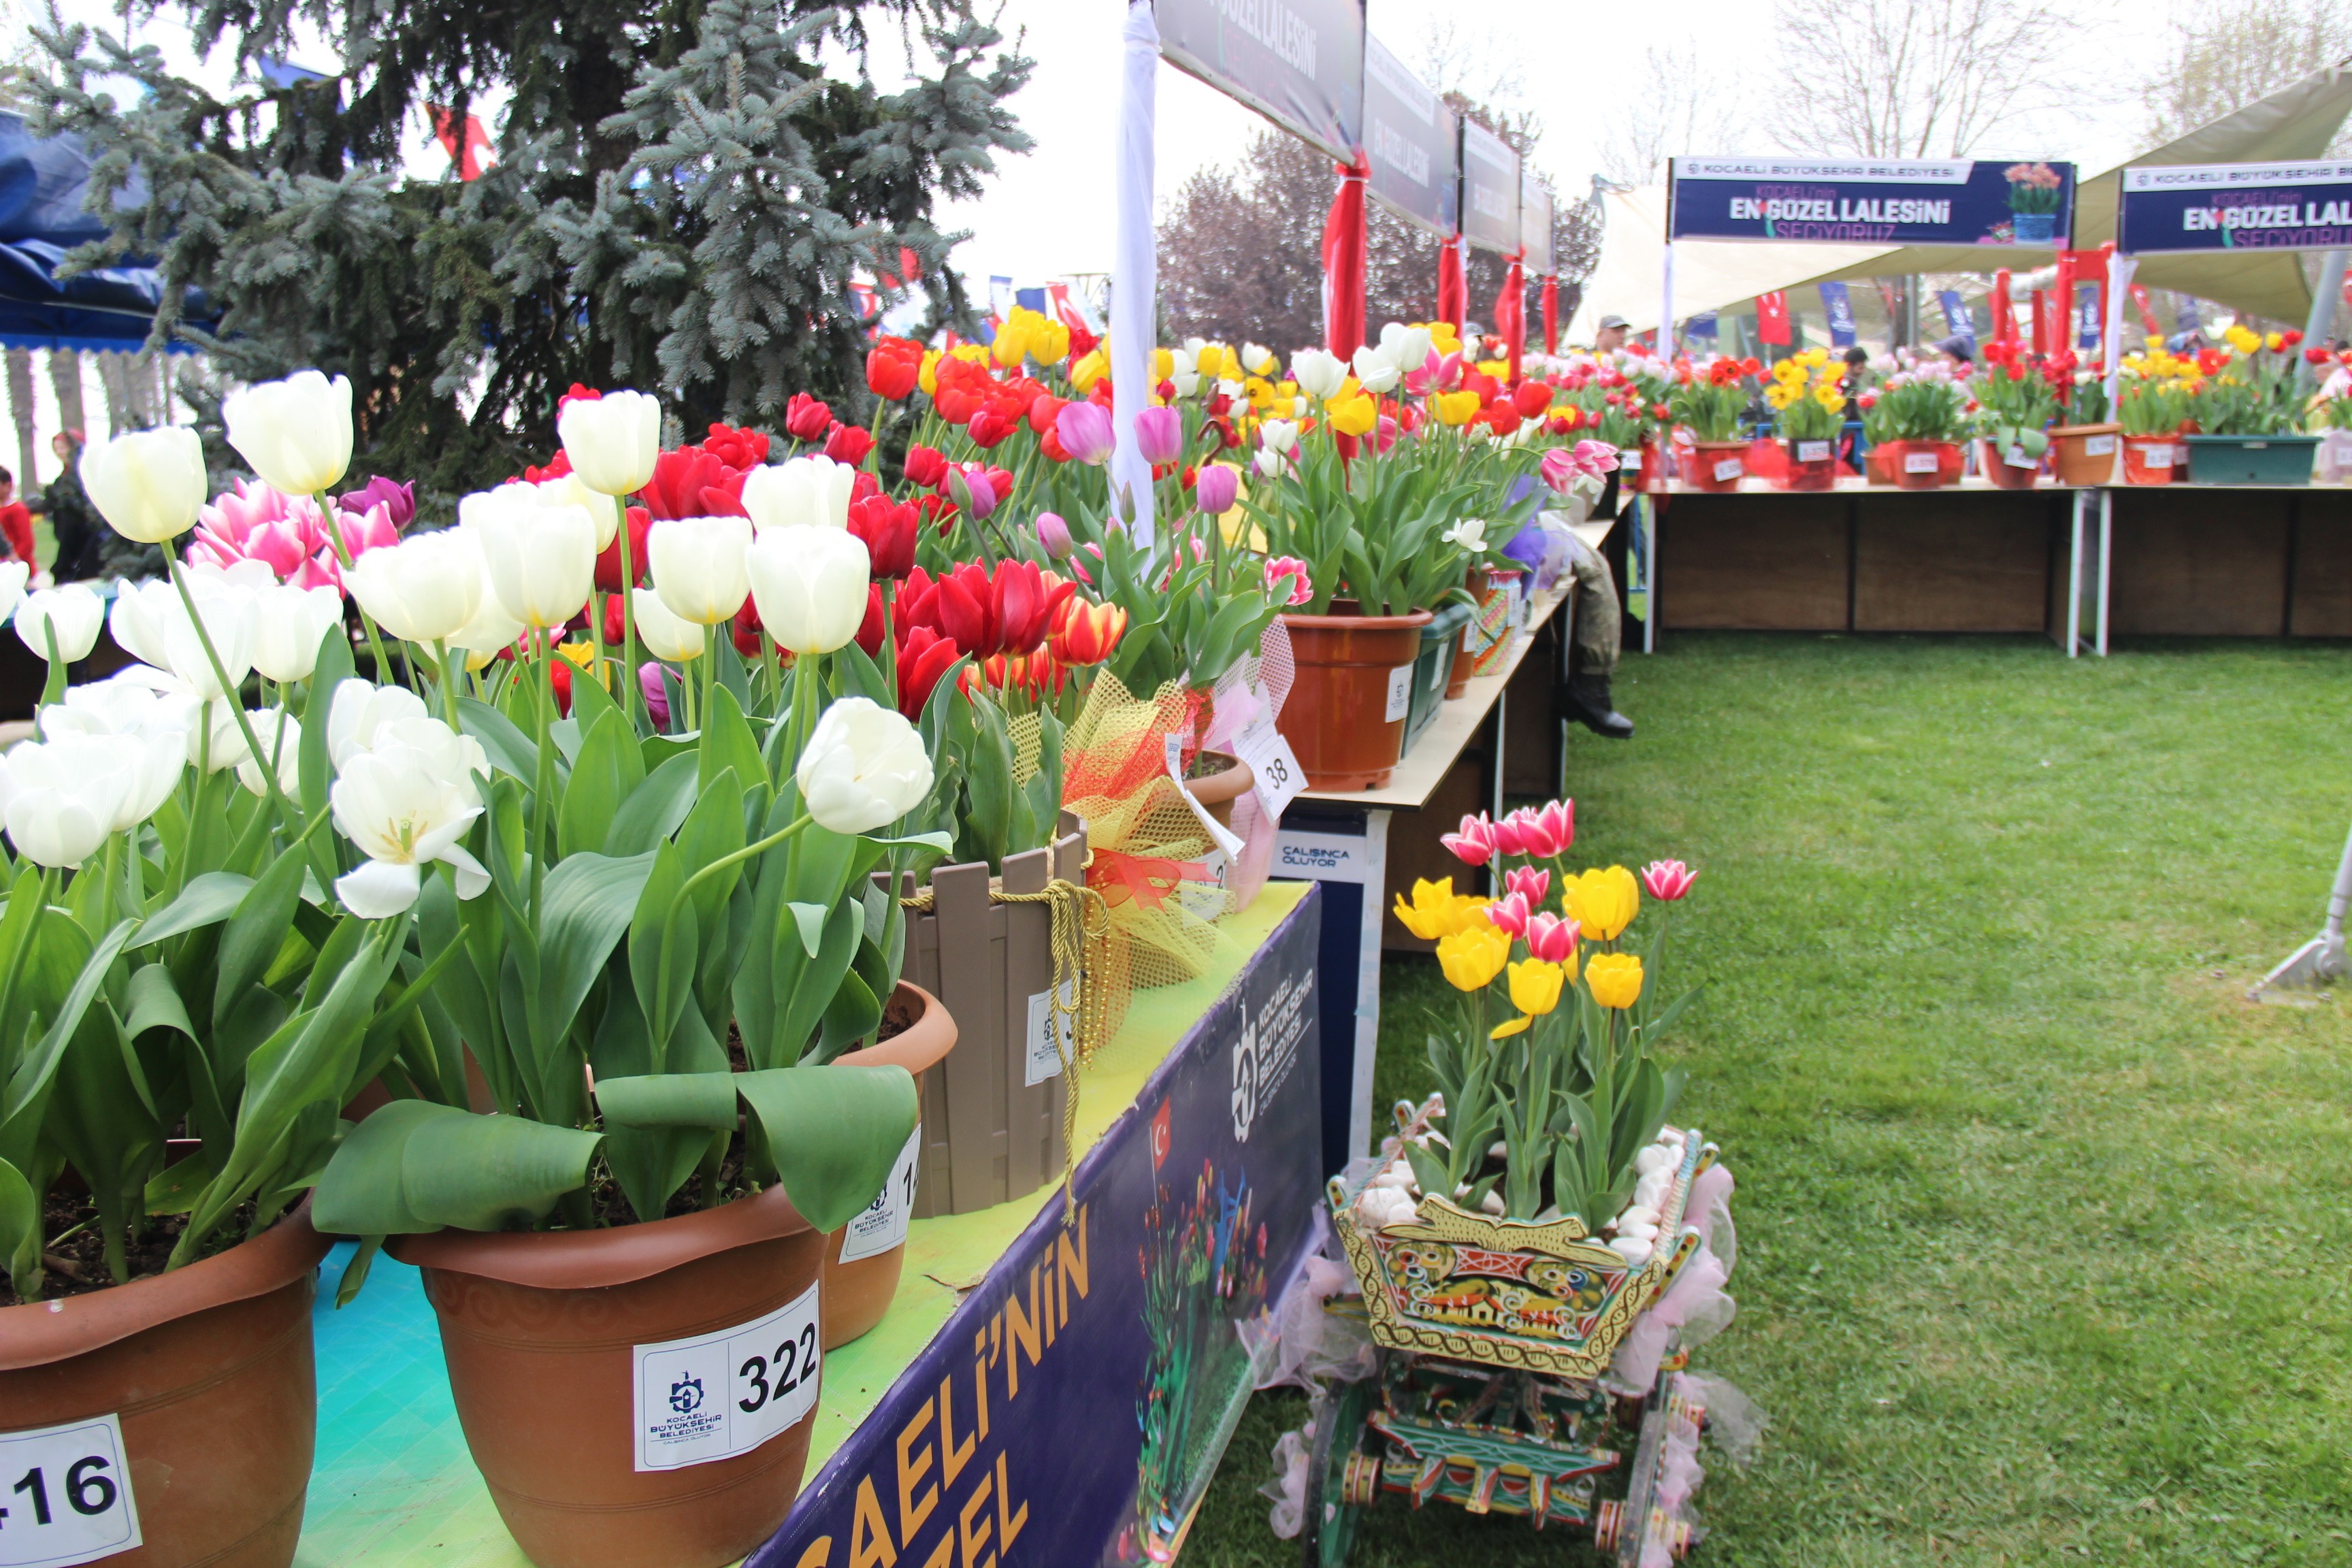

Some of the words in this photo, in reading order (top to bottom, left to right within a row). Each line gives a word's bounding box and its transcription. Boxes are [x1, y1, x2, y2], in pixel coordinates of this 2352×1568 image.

[1729, 197, 1761, 220] EN
[2183, 207, 2219, 231] EN
[1267, 757, 1288, 790] 38
[1283, 846, 1350, 859] ÇALIŞINCA
[1283, 856, 1336, 867] OLUYOR
[738, 1322, 817, 1414] 322
[0, 1455, 117, 1530] 16
